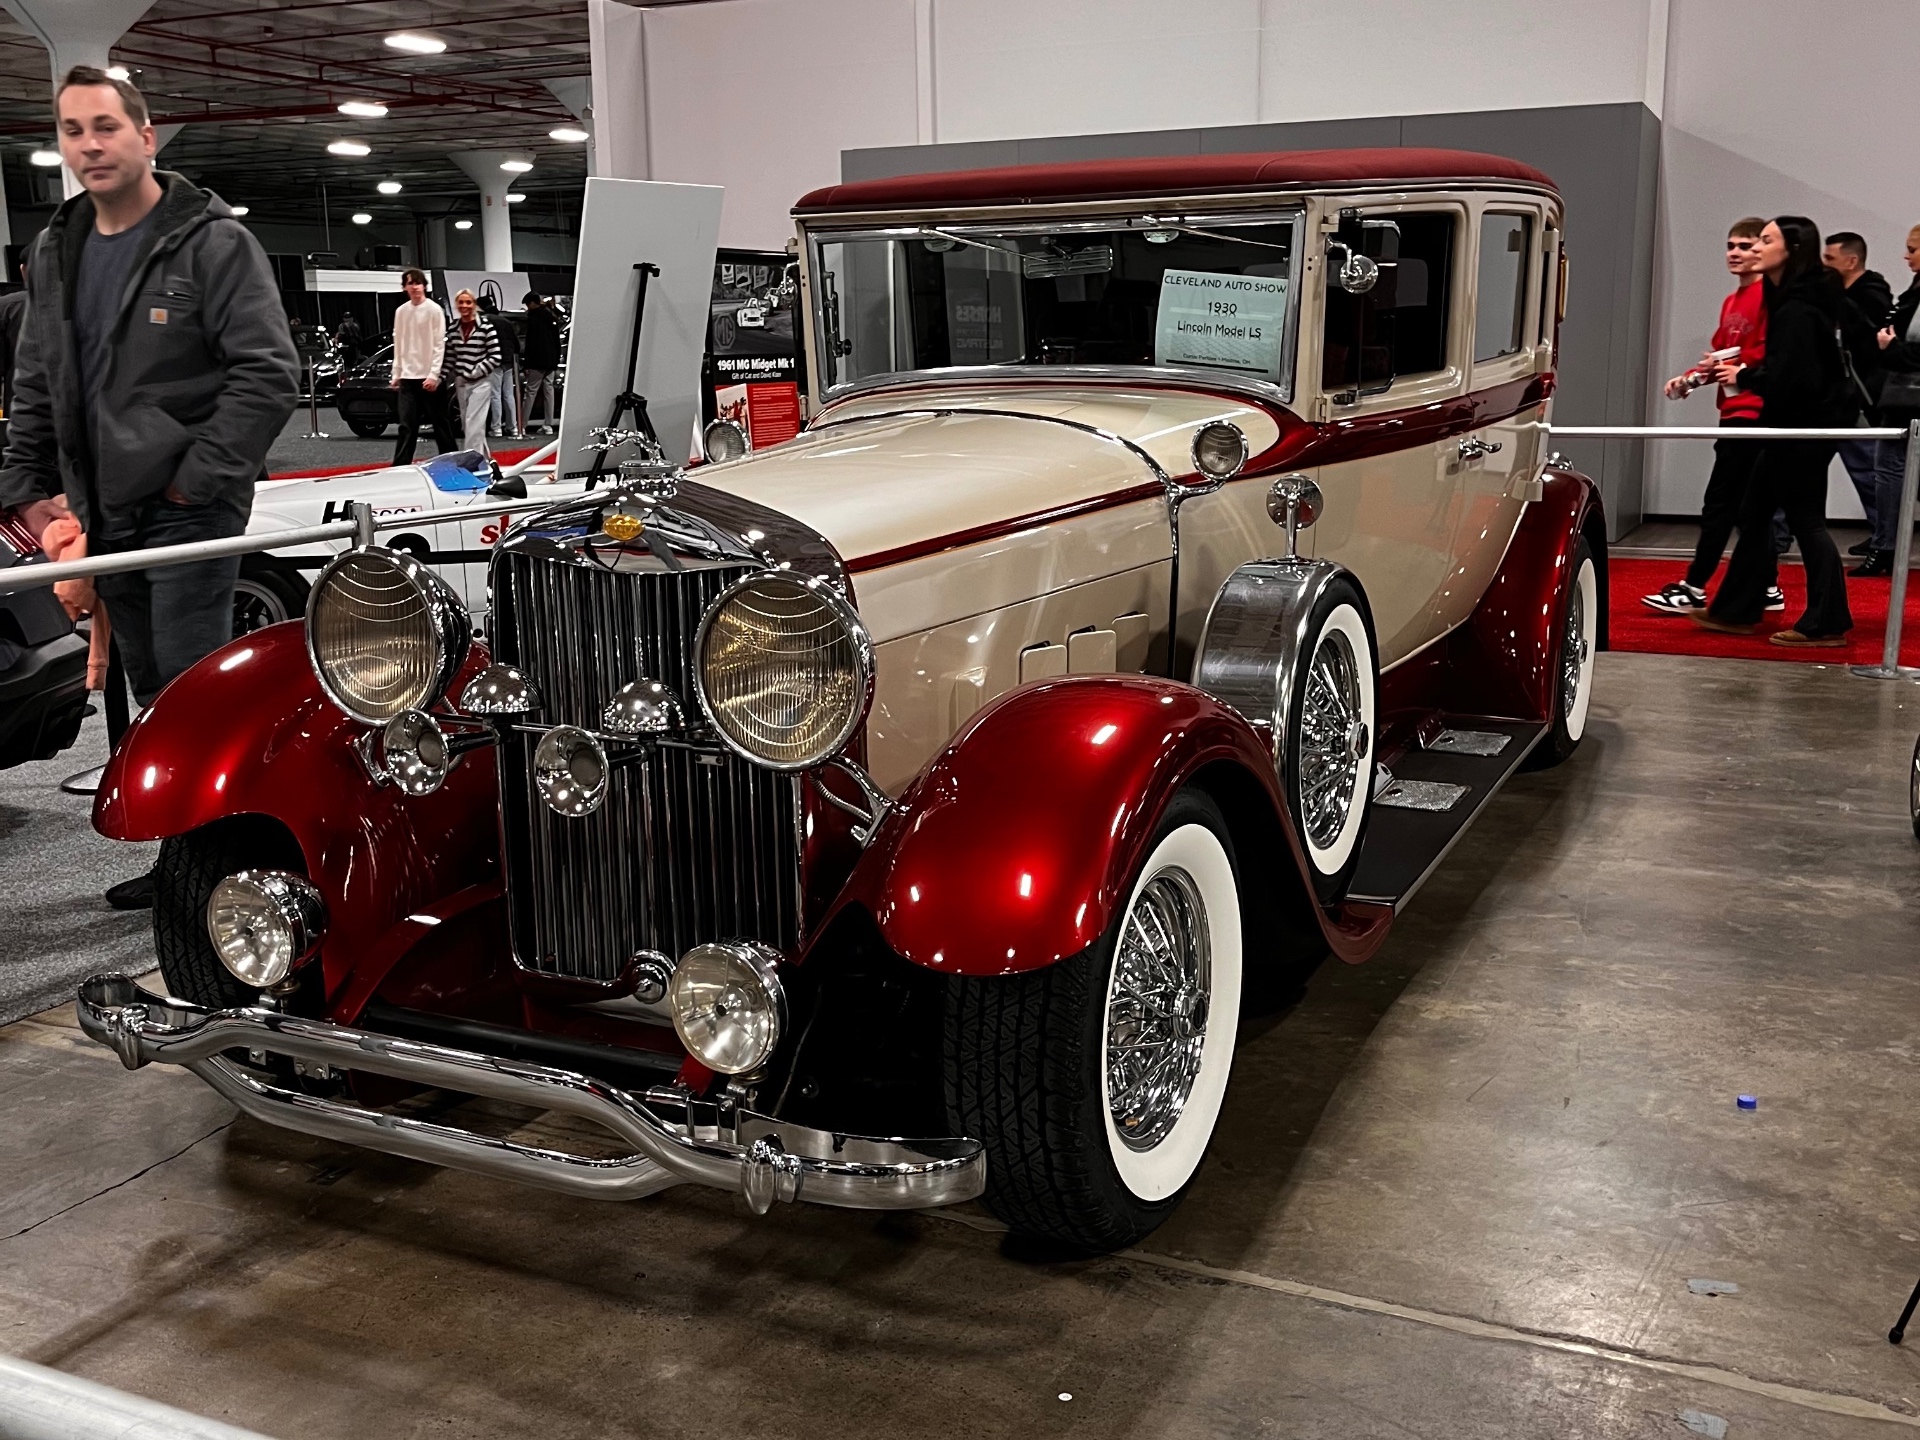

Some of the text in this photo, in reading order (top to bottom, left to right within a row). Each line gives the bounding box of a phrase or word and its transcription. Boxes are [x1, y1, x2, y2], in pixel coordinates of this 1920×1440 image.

[1164, 275, 1287, 294] CLEVELAND AUTO SHOW
[1207, 301, 1238, 315] 1930
[1177, 320, 1262, 338] Lincoln Model LS
[717, 357, 795, 372] 1961 MG Midget Mk 1
